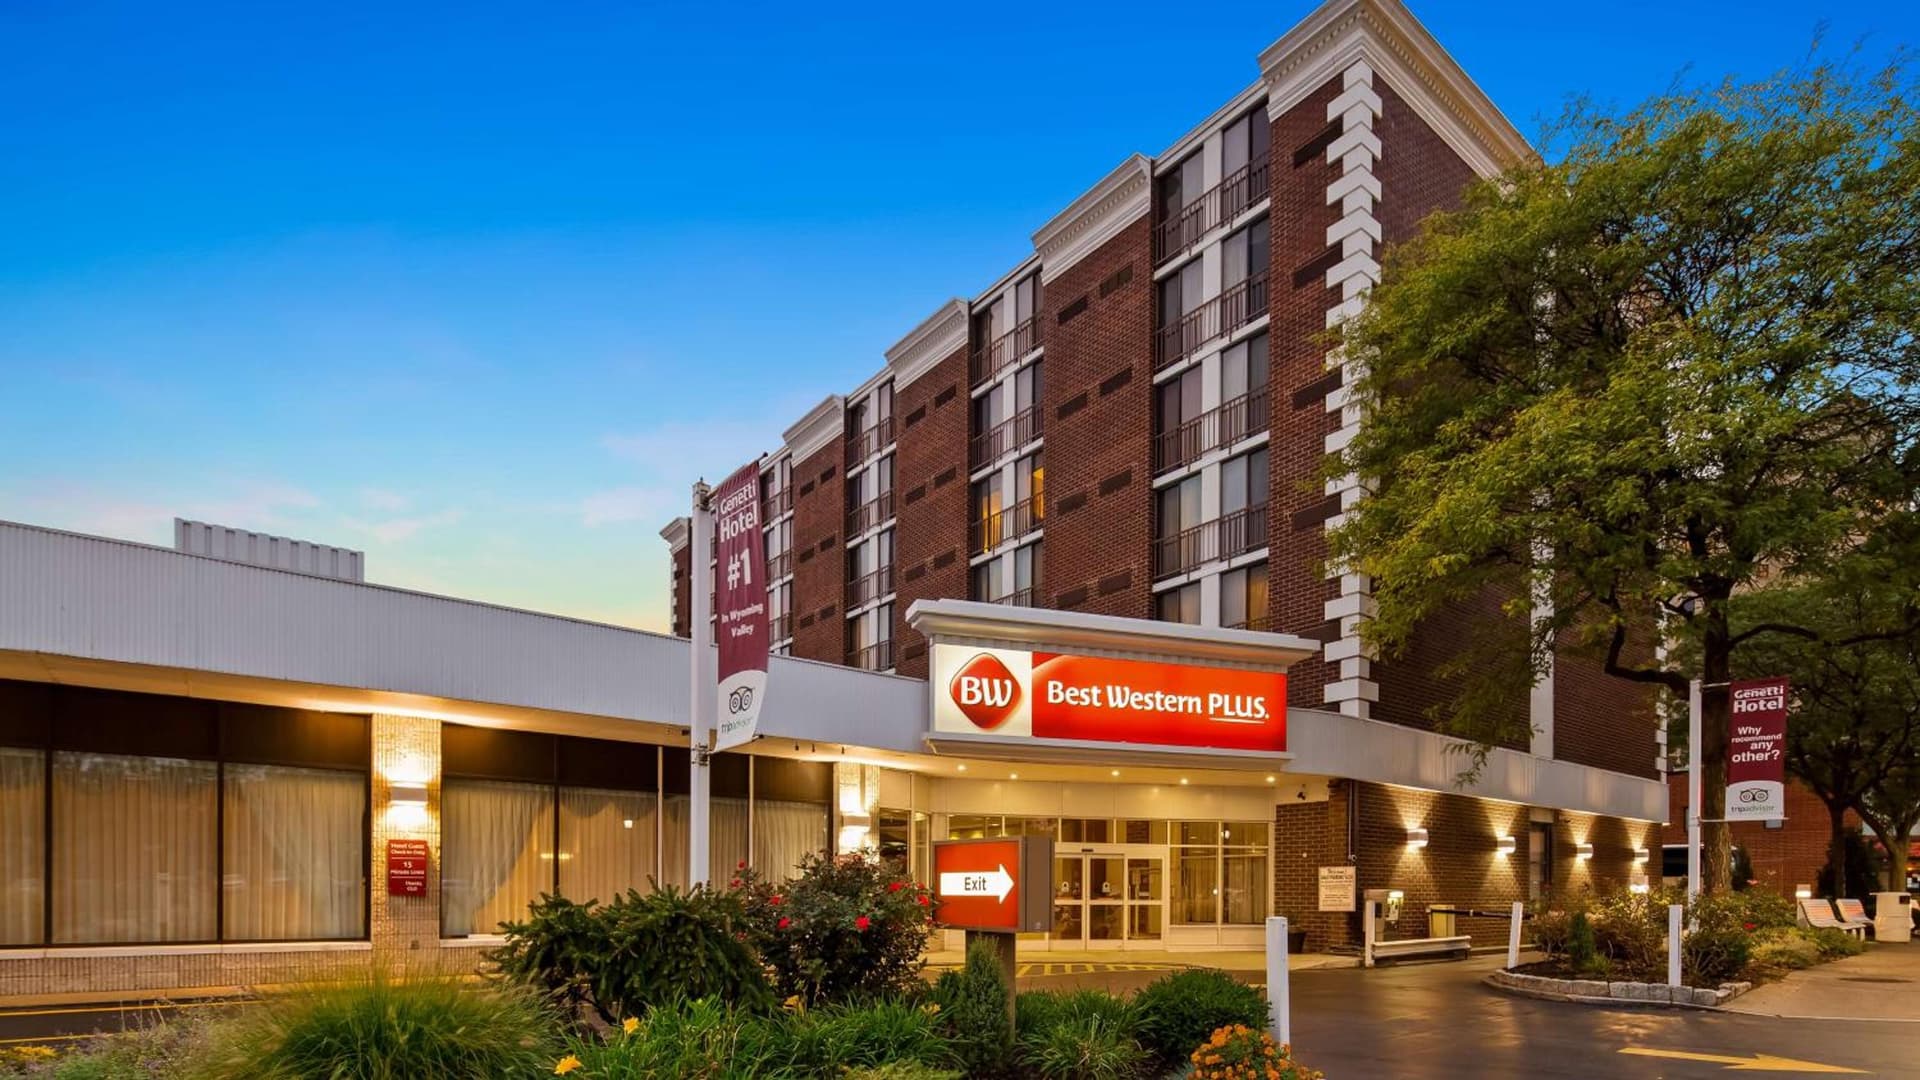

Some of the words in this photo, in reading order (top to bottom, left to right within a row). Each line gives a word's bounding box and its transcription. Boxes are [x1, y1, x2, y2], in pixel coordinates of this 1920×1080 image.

[720, 500, 758, 543] Hotel
[727, 548, 752, 591] #1
[960, 676, 1012, 708] BW
[1047, 680, 1102, 707] Best
[1107, 686, 1202, 715] Western
[1734, 685, 1784, 700] Genetti
[1733, 696, 1784, 714] Hotel
[1731, 733, 1782, 744] recommend
[1737, 726, 1762, 736] Why
[1750, 740, 1774, 751] any
[1731, 749, 1781, 763] other?
[964, 876, 987, 891] Exit
